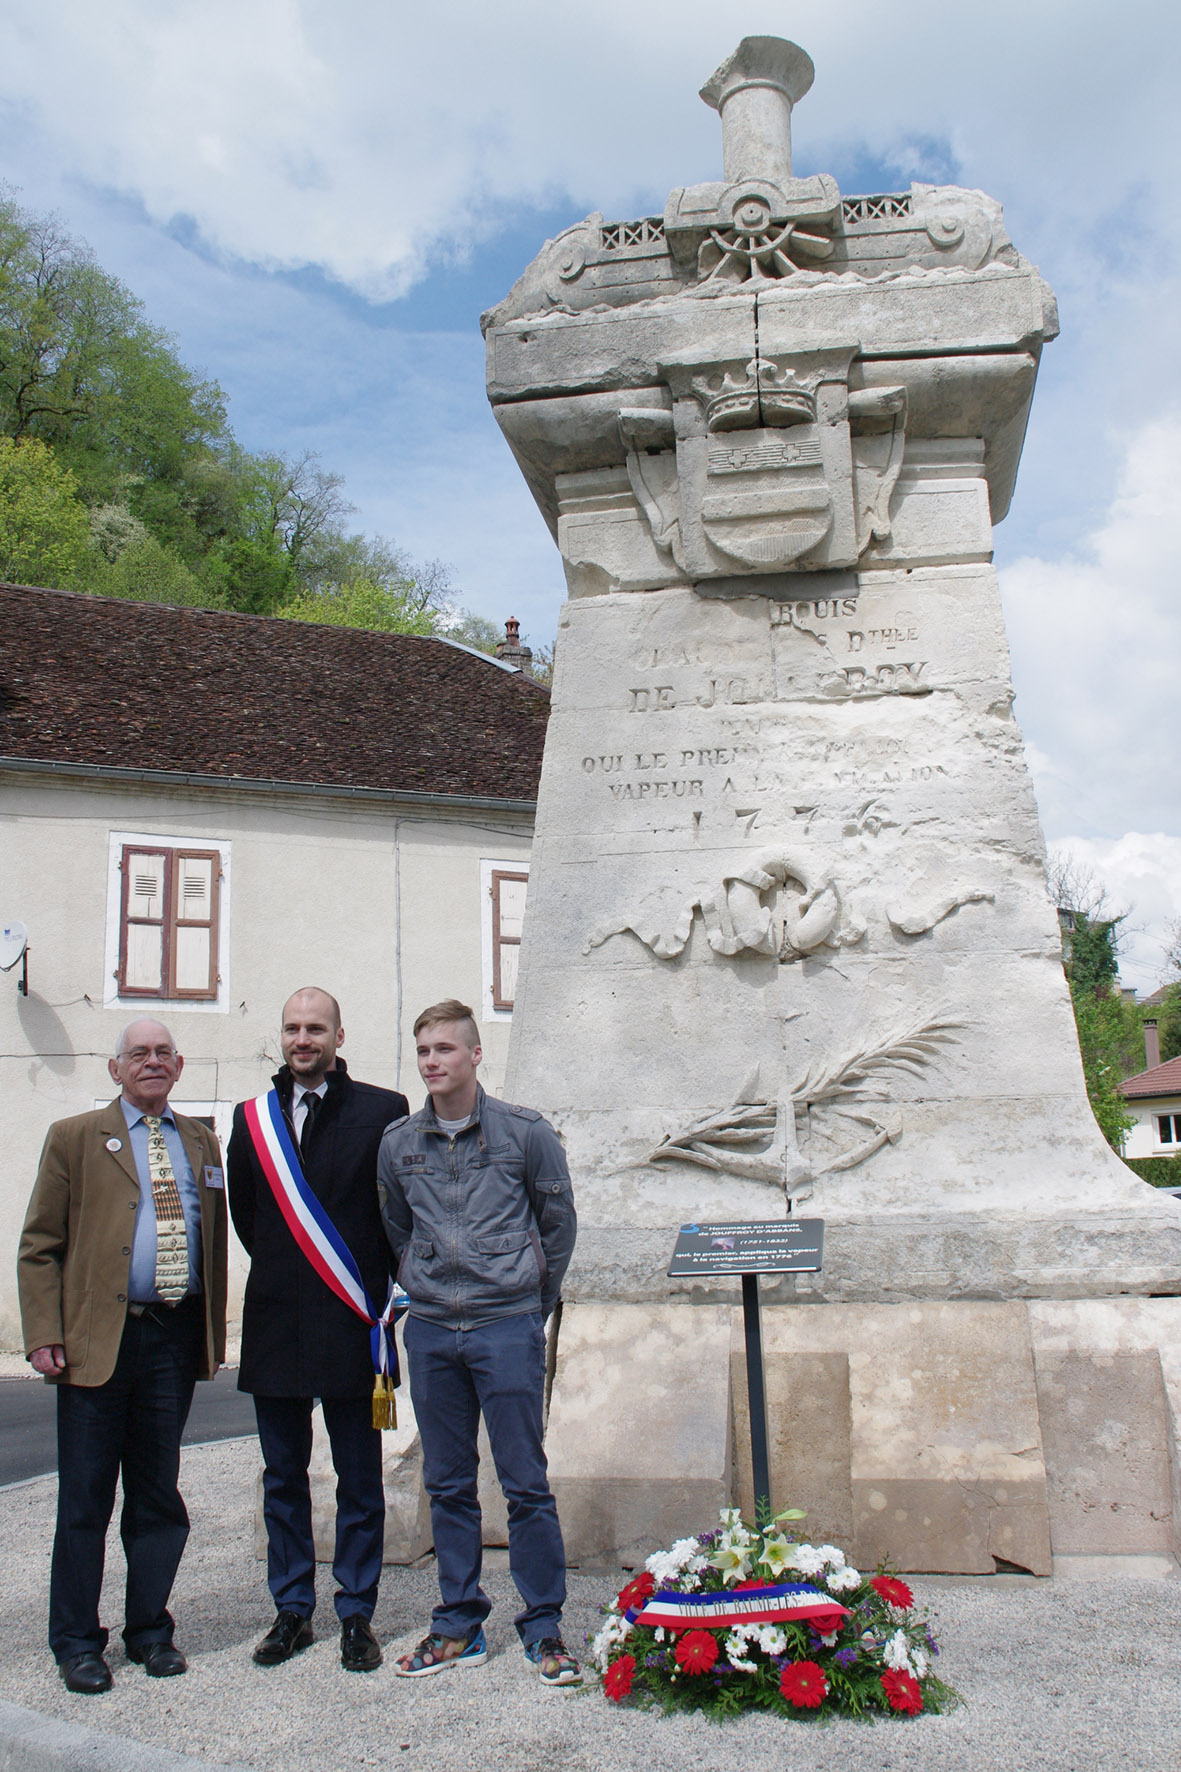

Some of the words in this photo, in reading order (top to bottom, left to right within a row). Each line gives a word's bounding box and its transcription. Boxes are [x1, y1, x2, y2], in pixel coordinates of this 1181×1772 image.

[634, 752, 669, 771] LE
[607, 779, 704, 801] VAPEUR
[765, 1222, 800, 1230] marquis
[709, 1254, 756, 1262] navigation
[678, 1600, 707, 1617] VILLE
[713, 1598, 728, 1616] DE
